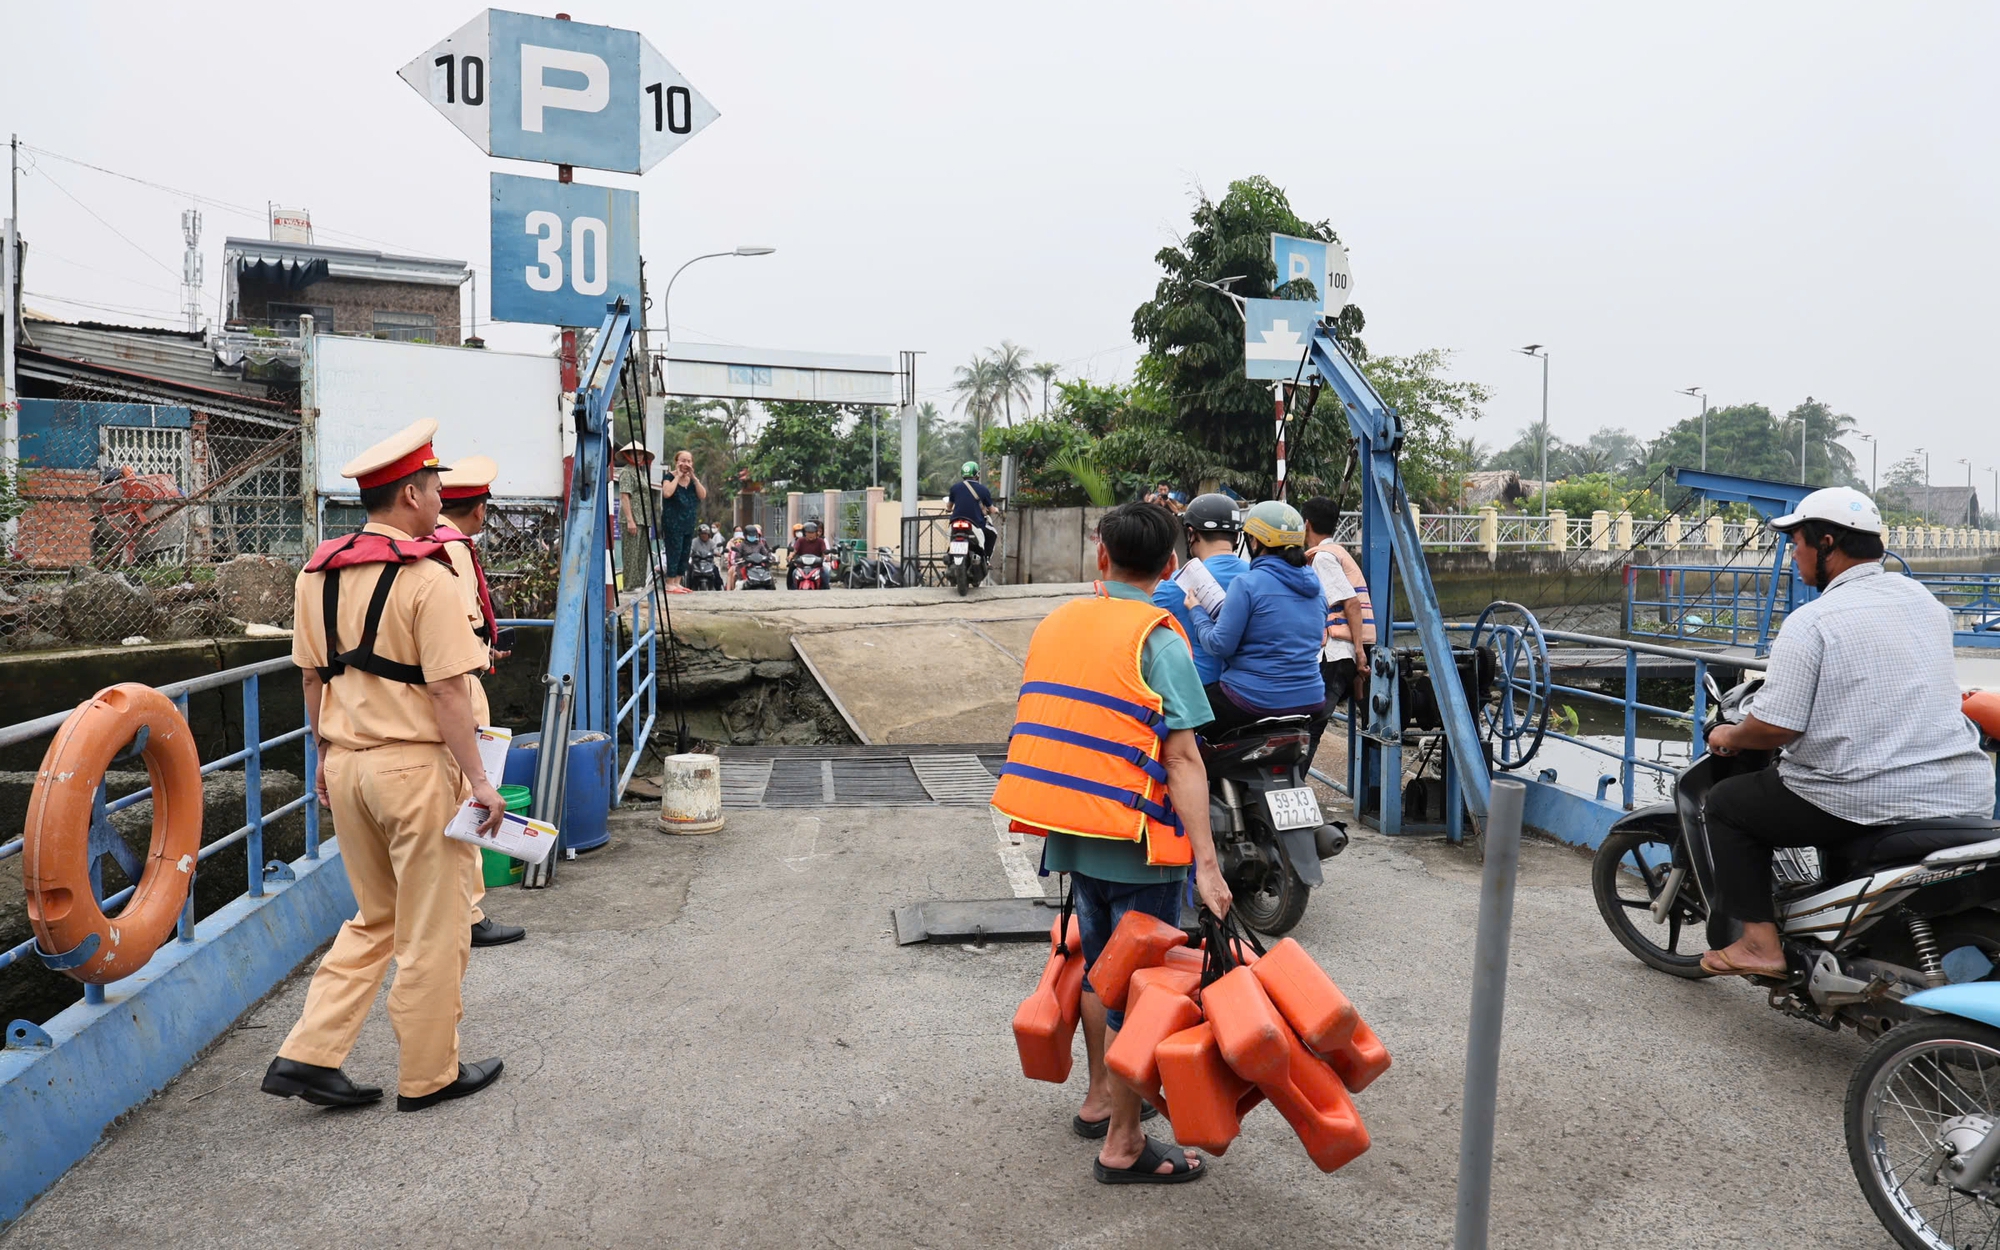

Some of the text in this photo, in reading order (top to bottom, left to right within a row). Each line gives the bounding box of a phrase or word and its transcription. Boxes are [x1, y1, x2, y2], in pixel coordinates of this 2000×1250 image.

[434, 53, 484, 106] 10
[521, 43, 610, 133] P
[645, 82, 692, 134] 10
[525, 210, 608, 296] 30
[1289, 252, 1311, 282] P
[1328, 271, 1348, 290] 100
